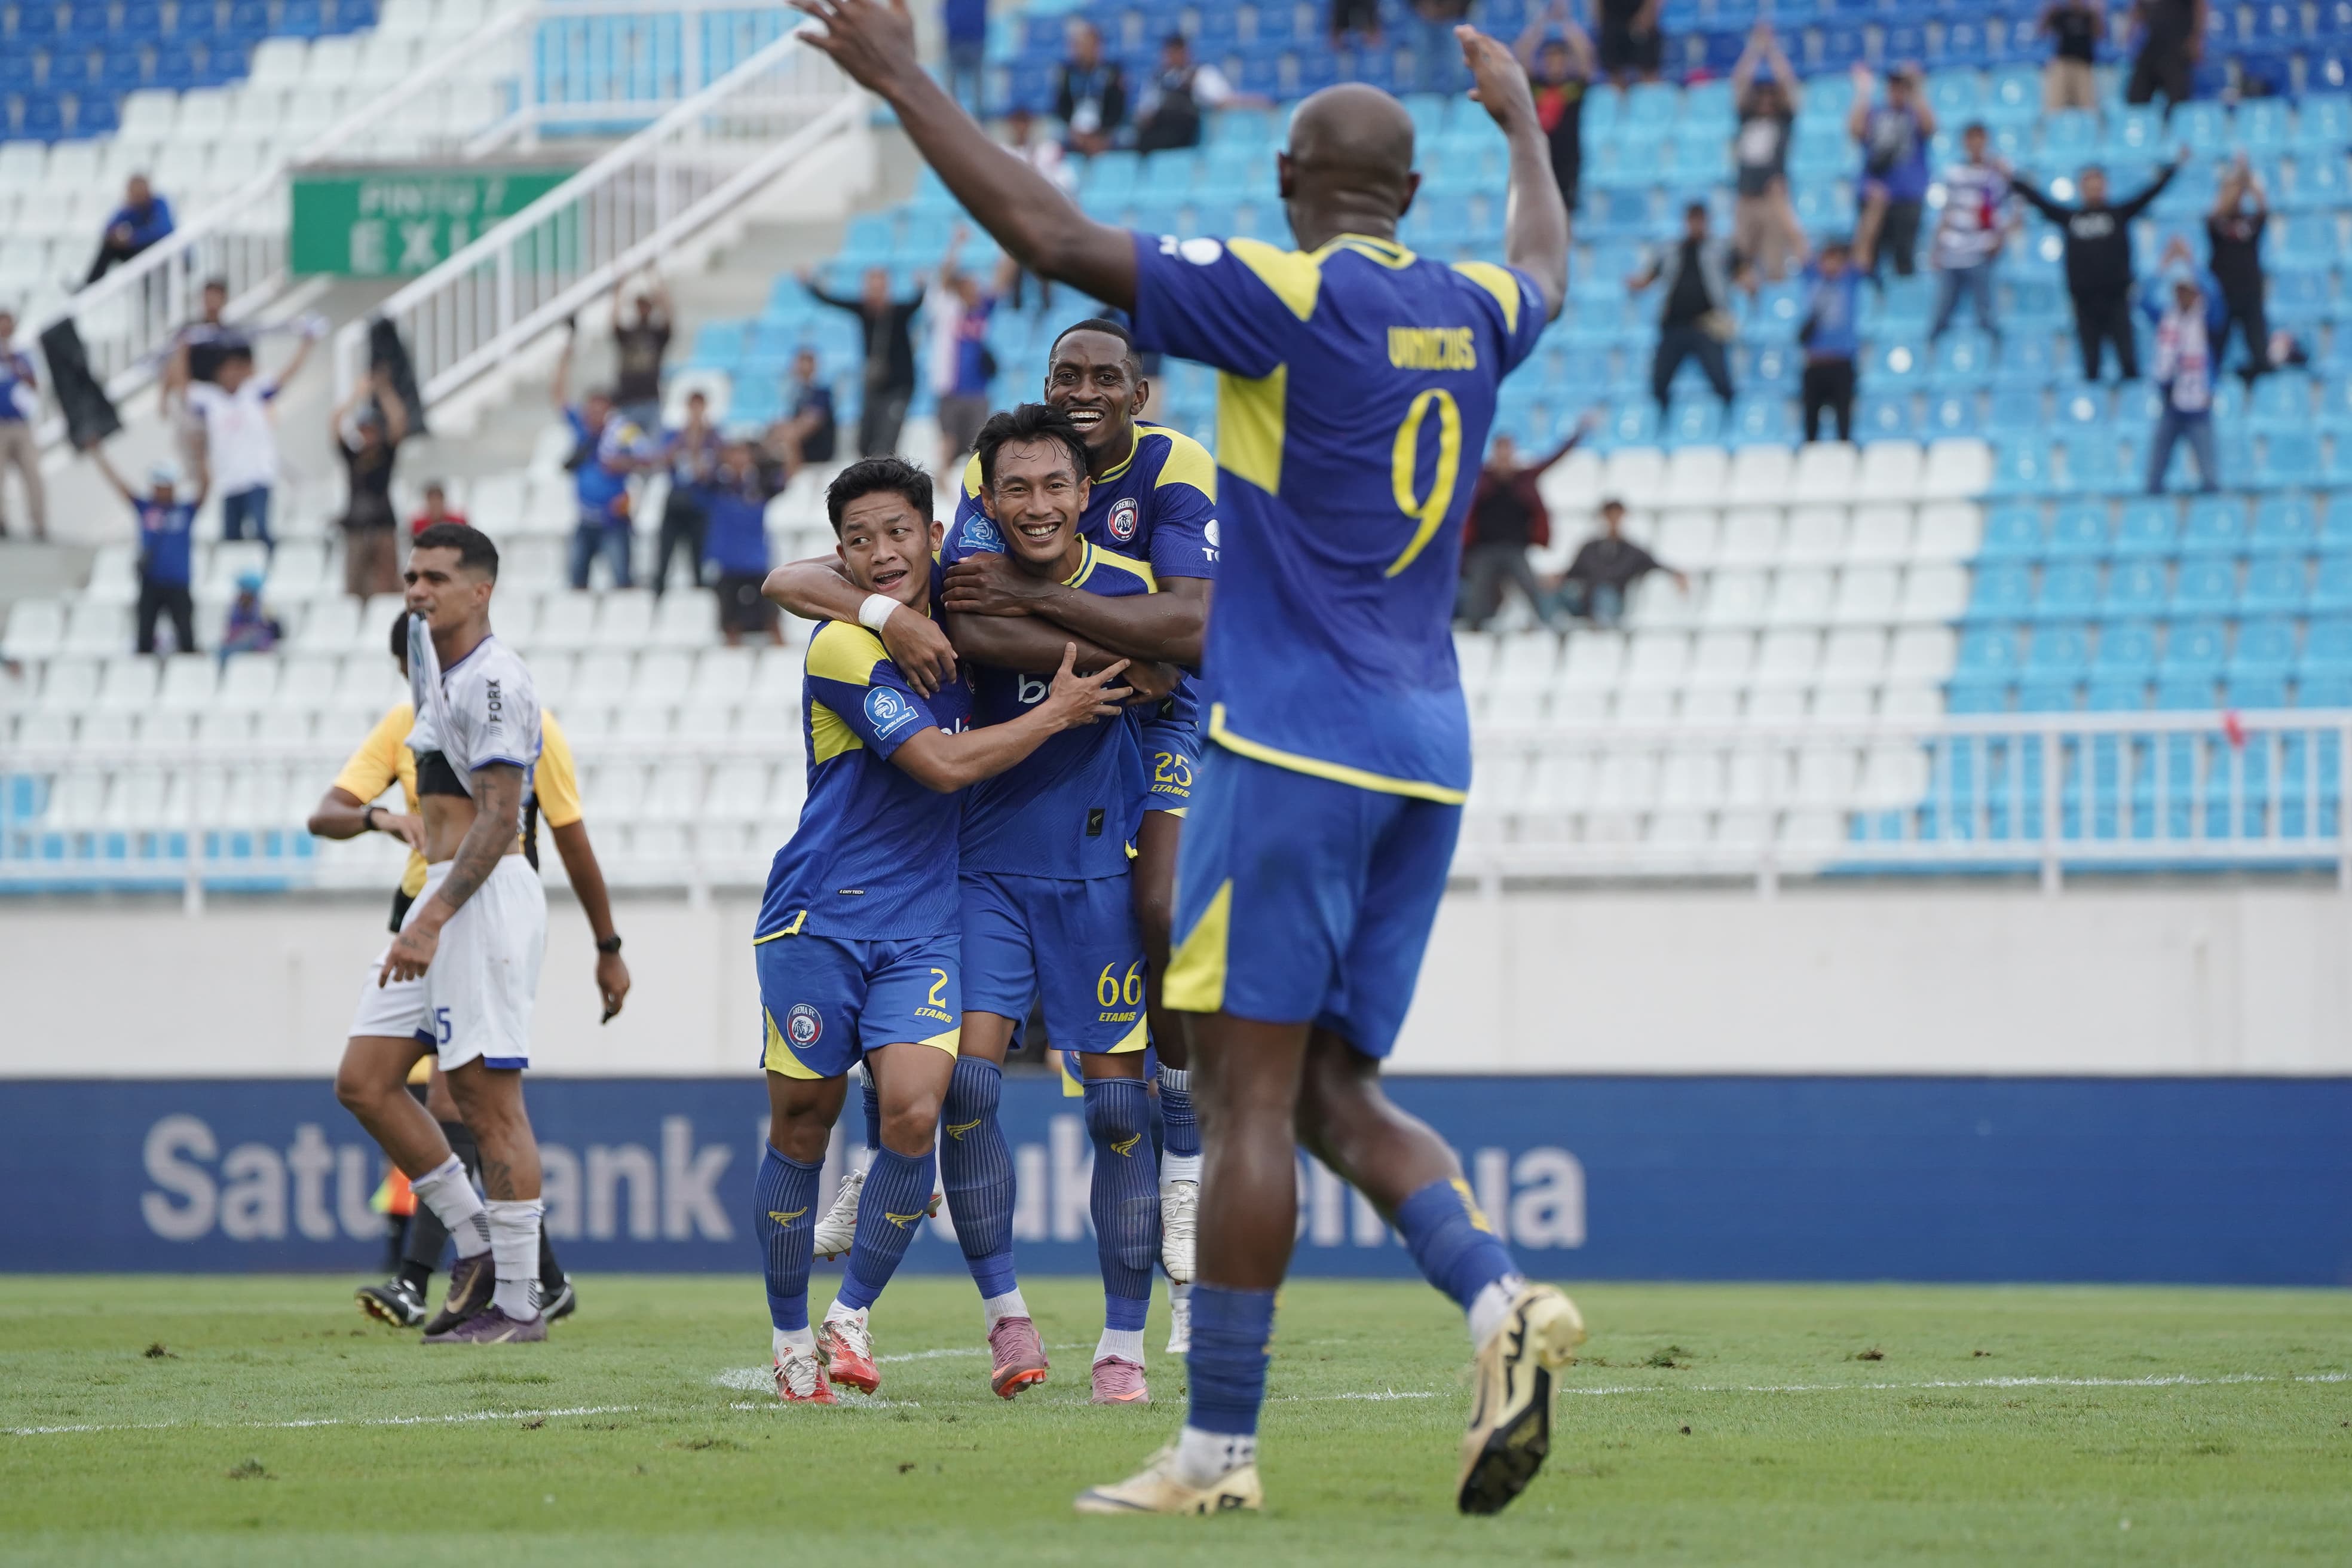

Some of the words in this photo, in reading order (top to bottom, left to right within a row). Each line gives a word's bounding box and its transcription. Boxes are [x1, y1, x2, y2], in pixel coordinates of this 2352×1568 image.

[350, 215, 508, 275] EXI
[1385, 388, 1462, 577] 9
[486, 678, 502, 722] FORK
[1154, 752, 1192, 787] 25
[1151, 784, 1191, 798] ETAMS
[928, 968, 948, 1009] 2
[1097, 960, 1141, 1007] 66
[792, 1006, 808, 1015] AREMA
[808, 1008, 815, 1018] FC
[914, 1007, 953, 1023] ETAMS
[1098, 1012, 1137, 1022] ETAMS
[534, 1115, 737, 1242] ank
